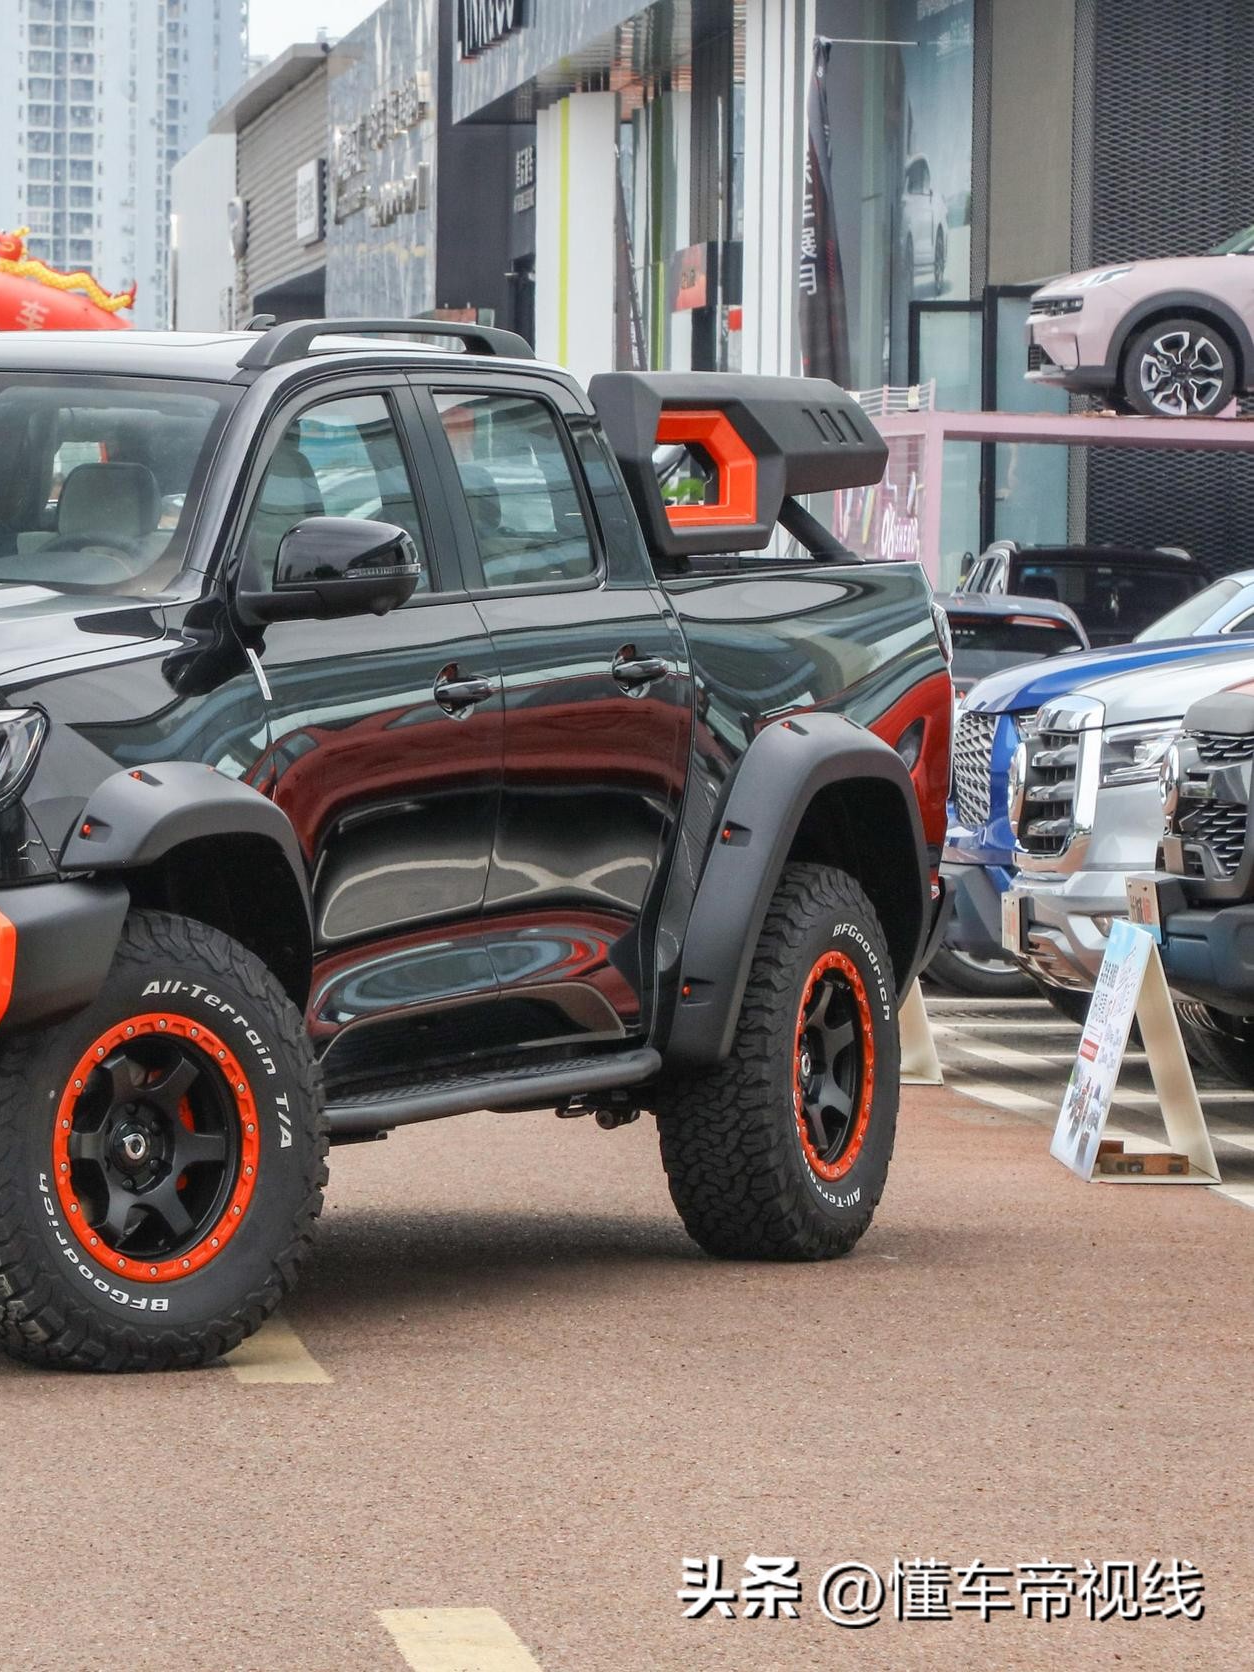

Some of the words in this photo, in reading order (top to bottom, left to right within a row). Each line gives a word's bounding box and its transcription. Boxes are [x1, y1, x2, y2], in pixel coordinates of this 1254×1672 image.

[832, 923, 890, 1021] BFGoodrich
[142, 980, 277, 1075] All-Terrain
[275, 1092, 292, 1149] T/A
[39, 1172, 169, 1312] BFGoodrich
